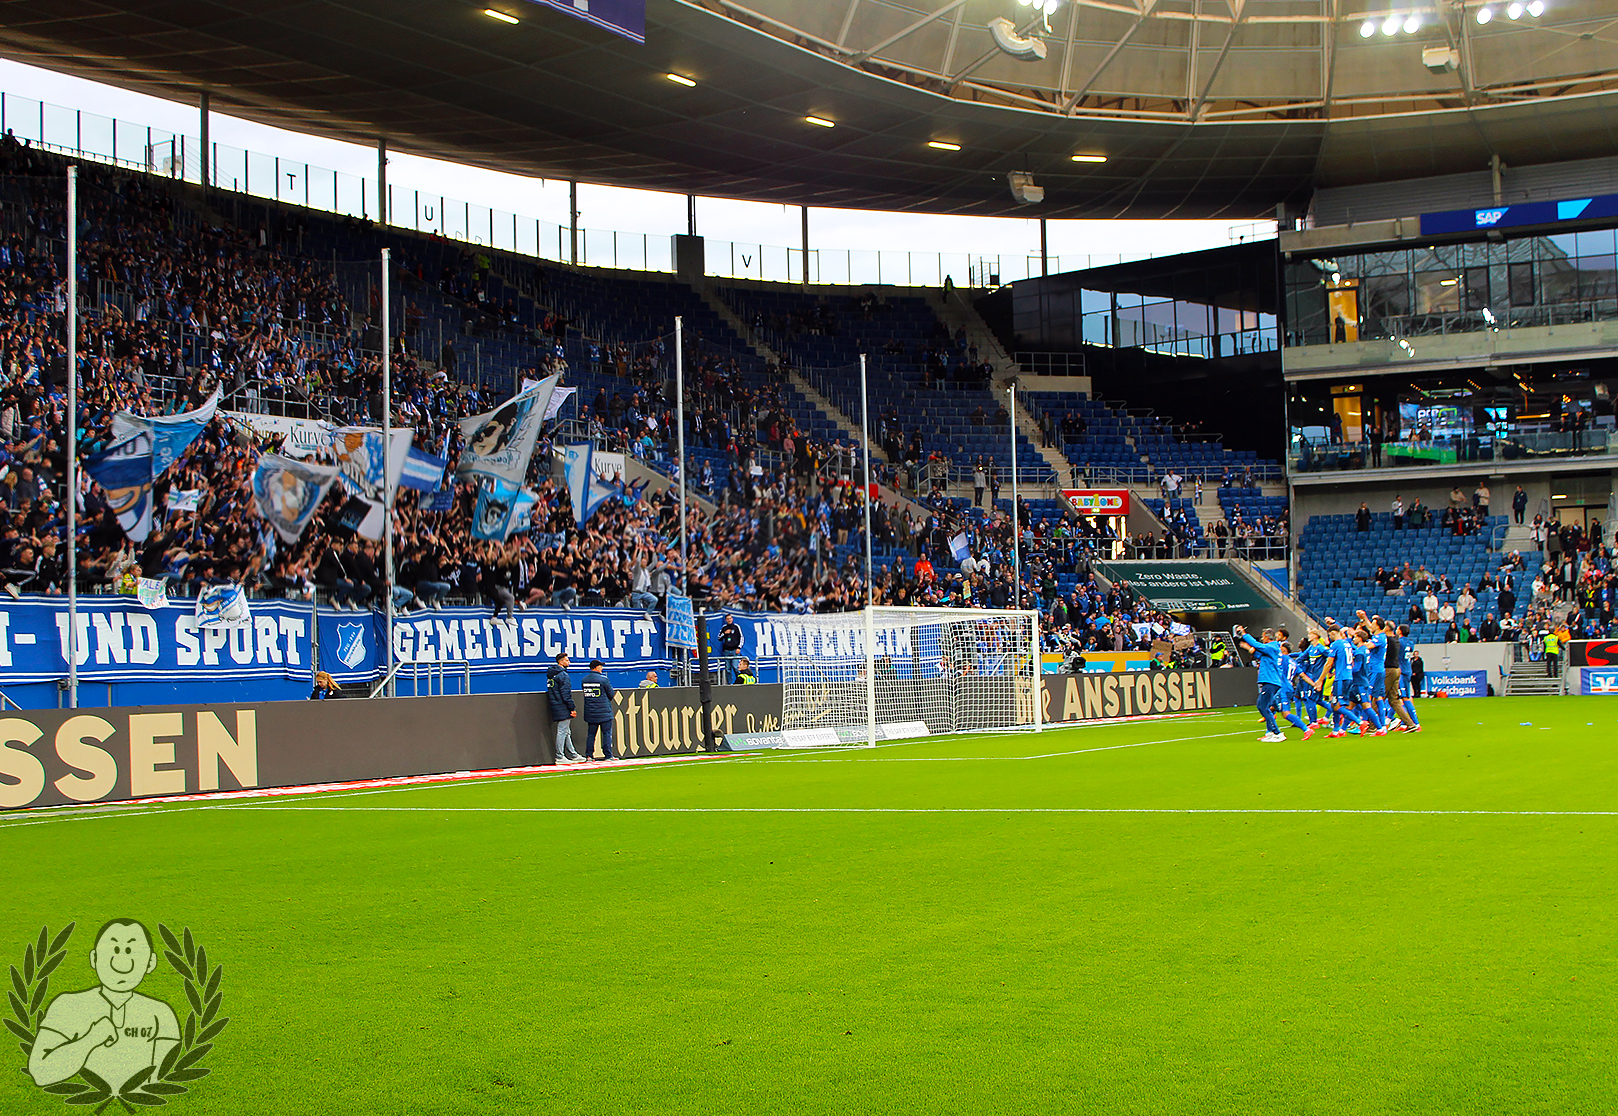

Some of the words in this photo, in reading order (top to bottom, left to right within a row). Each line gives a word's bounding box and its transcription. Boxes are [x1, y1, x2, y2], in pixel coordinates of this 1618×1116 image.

[286, 172, 297, 191] T
[424, 205, 434, 221] U
[1476, 211, 1502, 225] SAP
[741, 253, 752, 269] V
[594, 457, 622, 474] Kurve
[1135, 572, 1162, 580] Zero
[1162, 572, 1203, 580] Waste.
[1148, 580, 1187, 588] andere
[55, 611, 160, 666] UND
[175, 612, 305, 666] SPORT
[393, 617, 658, 663] GEMEINSCHAFT
[753, 621, 912, 657] HOFFENHEIM
[1430, 675, 1478, 685] Volksbank
[1063, 671, 1213, 721] ANSTOSSEN
